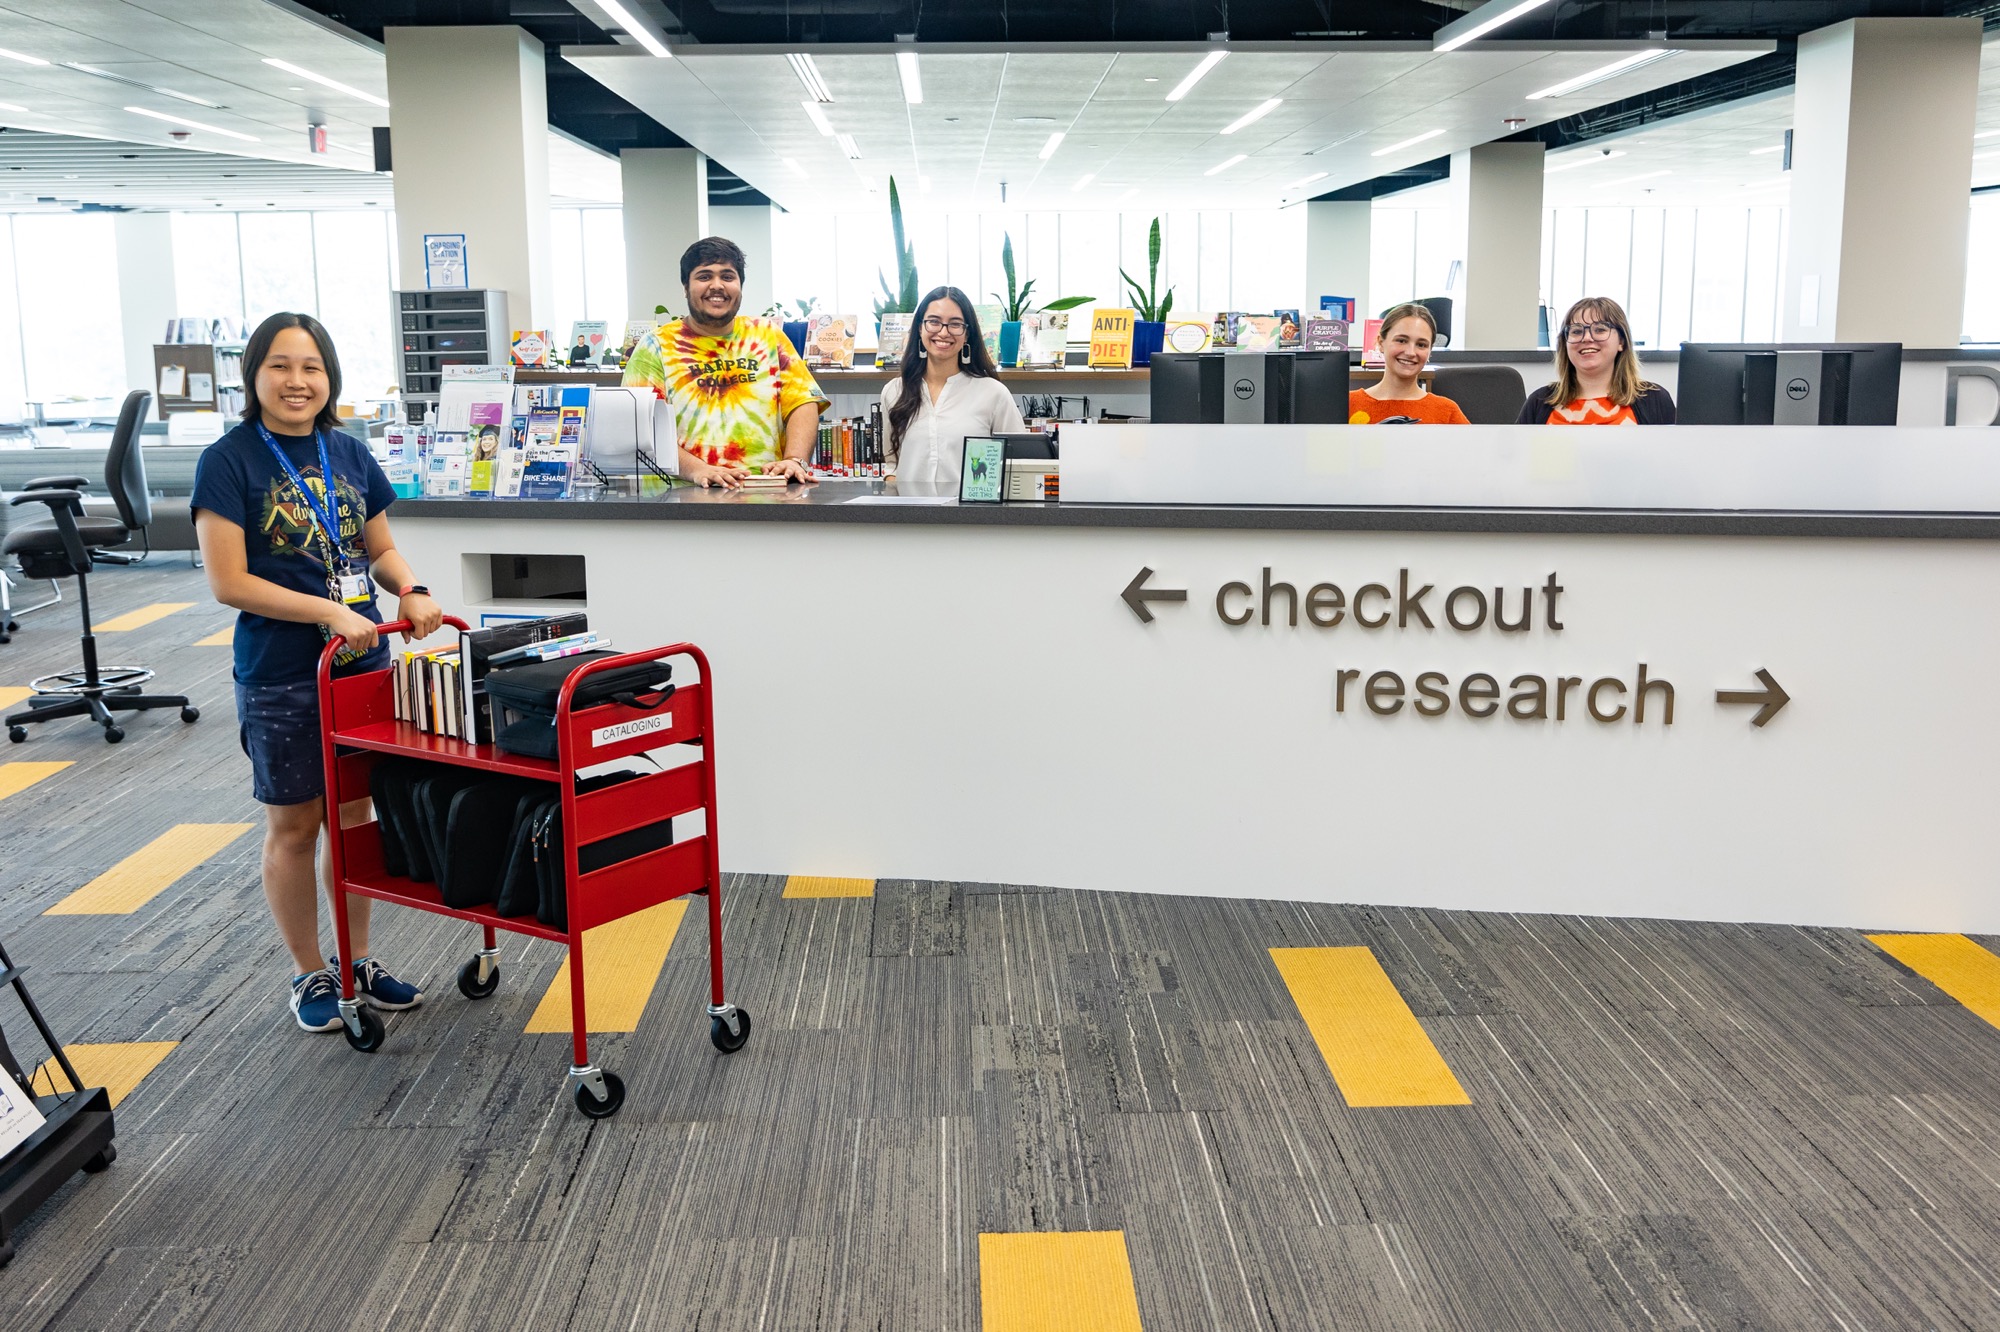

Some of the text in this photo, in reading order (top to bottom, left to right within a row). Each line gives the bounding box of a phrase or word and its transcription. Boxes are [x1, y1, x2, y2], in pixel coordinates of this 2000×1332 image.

[1093, 343, 1128, 357] DIET
[688, 358, 759, 377] HARPER
[697, 373, 757, 387] COLLEGE
[523, 474, 540, 482] BIKE
[1215, 566, 1565, 632] checkout
[1335, 662, 1676, 725] research
[602, 717, 661, 740] CATALOGING
